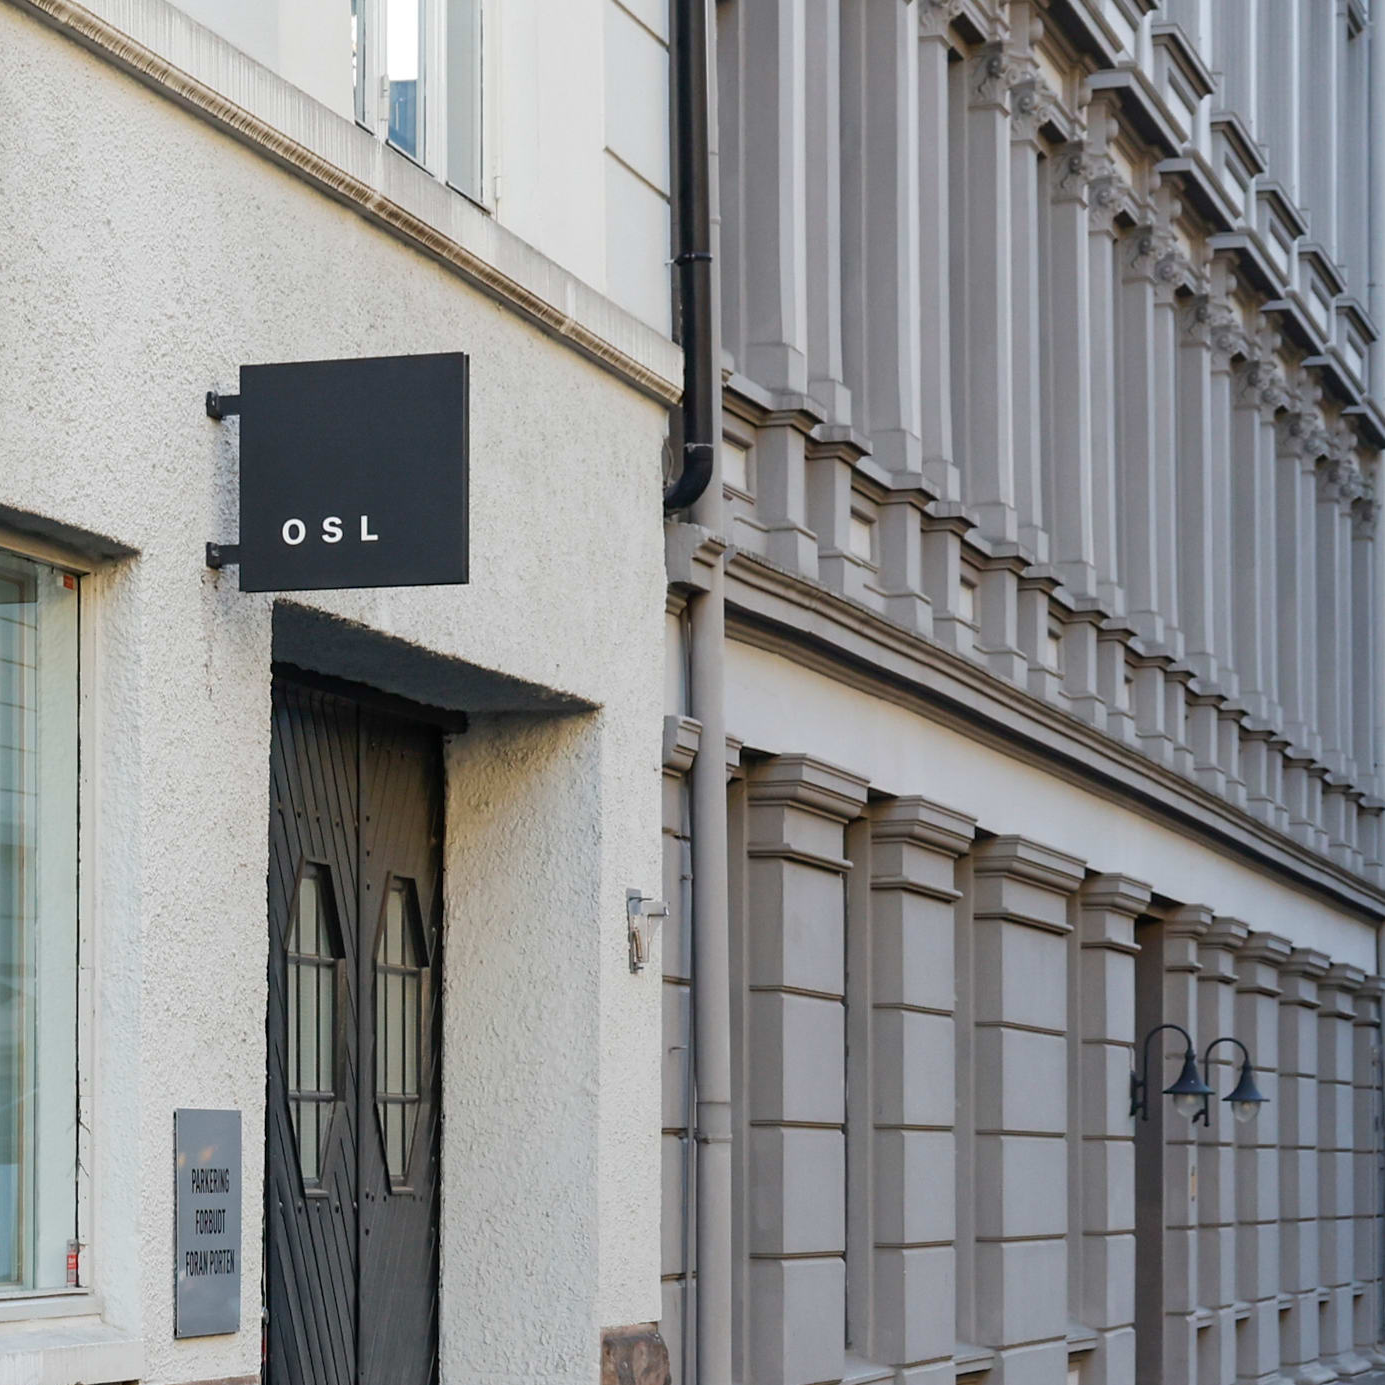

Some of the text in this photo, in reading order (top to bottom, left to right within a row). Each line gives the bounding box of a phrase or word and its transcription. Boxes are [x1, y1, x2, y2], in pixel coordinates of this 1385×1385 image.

[282, 514, 379, 546] OSL
[191, 1168, 230, 1194] PARKERING
[195, 1208, 227, 1235] FORBUDT
[185, 1249, 235, 1277] FORAN PORTEN
